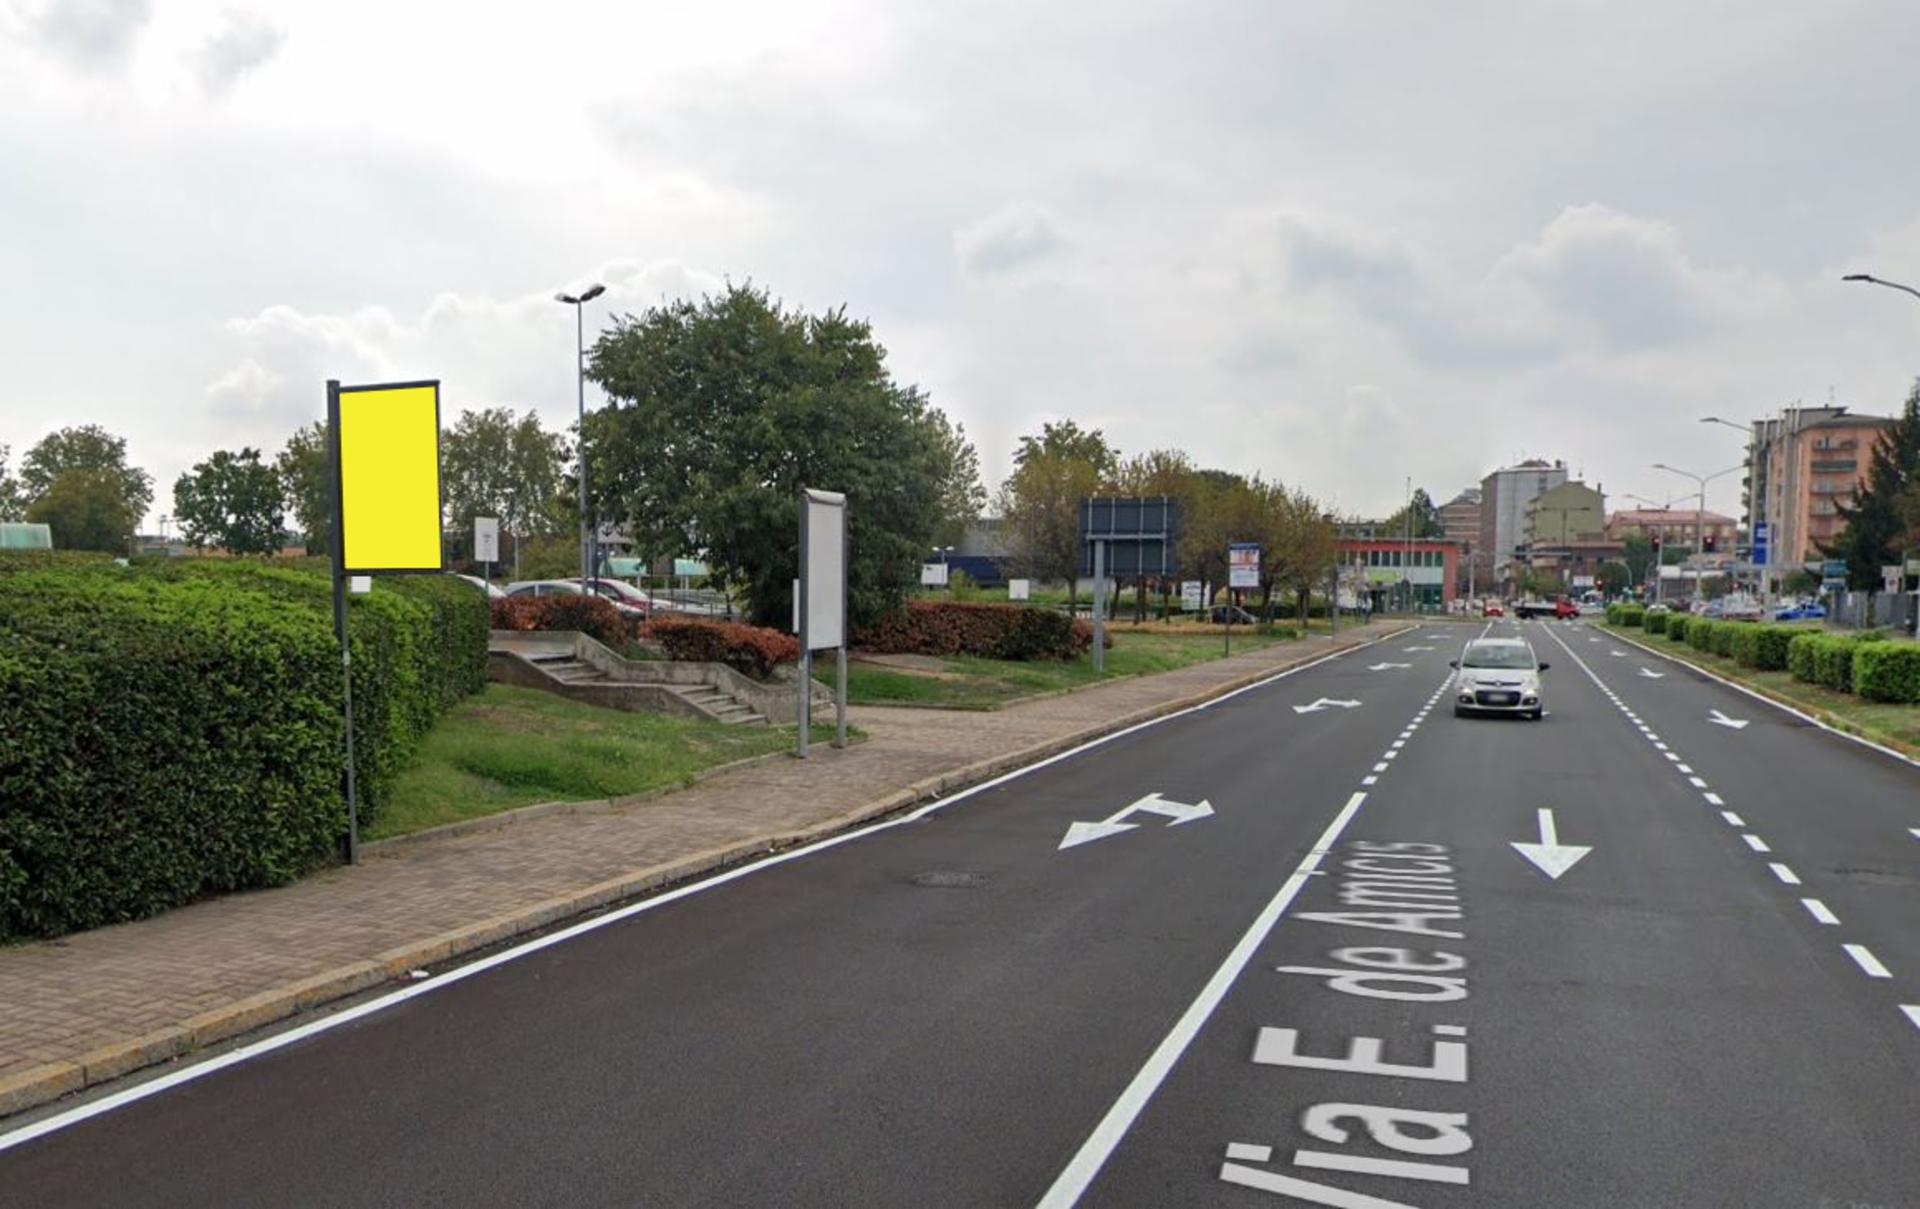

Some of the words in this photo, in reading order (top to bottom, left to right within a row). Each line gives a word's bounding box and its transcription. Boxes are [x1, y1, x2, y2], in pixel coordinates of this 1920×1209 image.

[1293, 841, 1465, 939] Amicis
[1276, 946, 1469, 1002] de
[1253, 1025, 1467, 1082] E.
